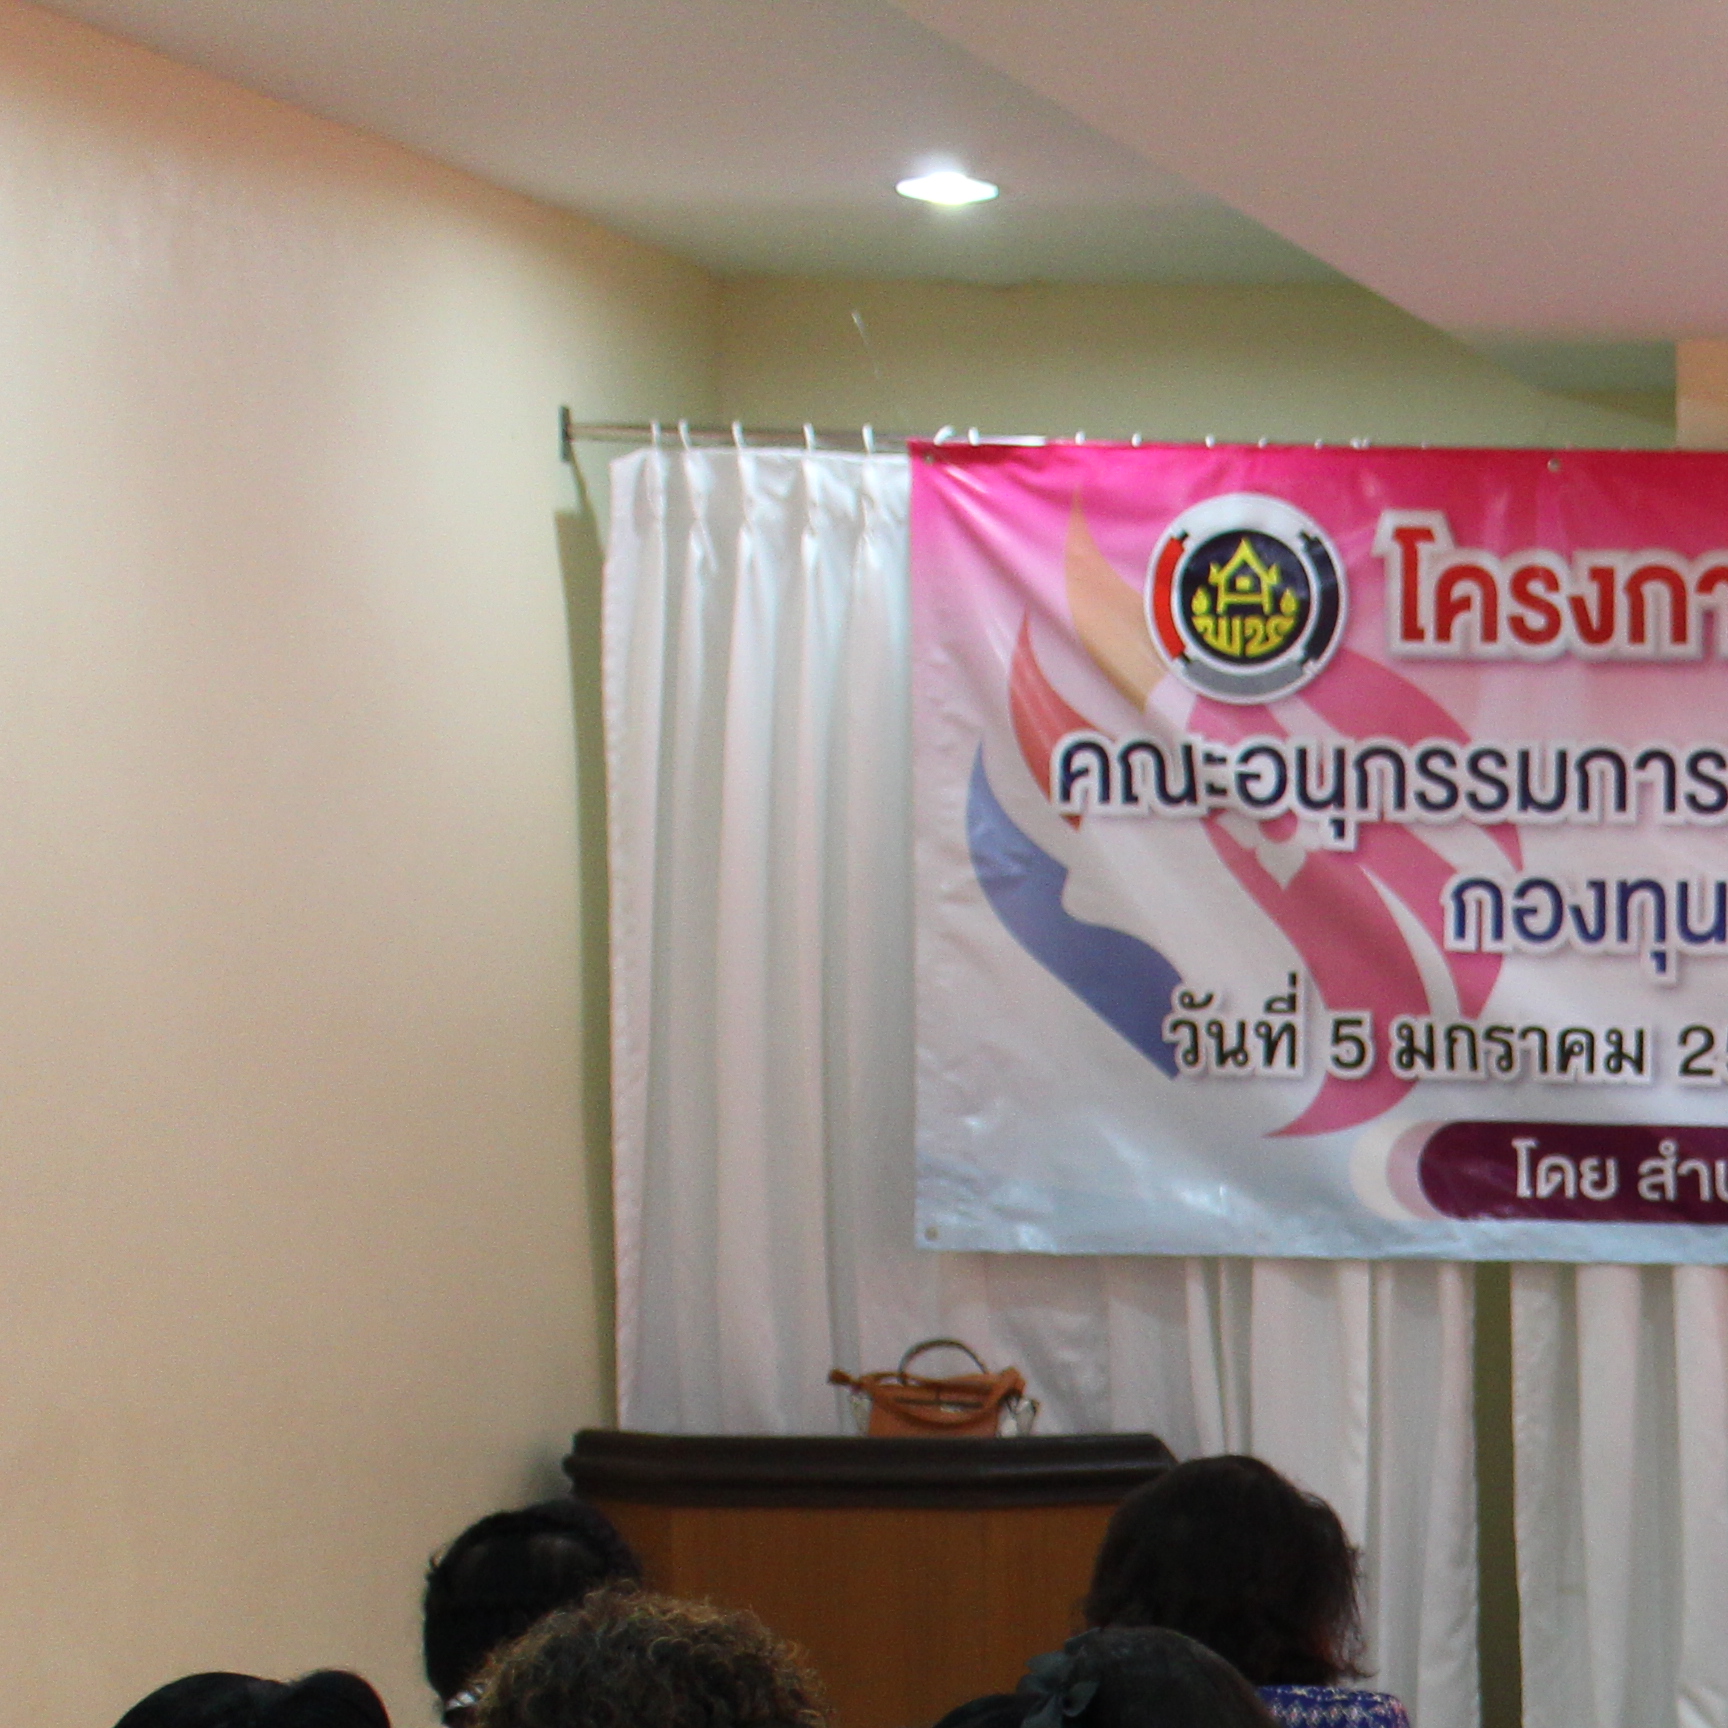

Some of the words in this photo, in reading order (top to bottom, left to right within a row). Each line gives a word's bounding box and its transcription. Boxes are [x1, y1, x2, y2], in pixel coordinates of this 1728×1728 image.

[1168, 971, 1298, 1068] วันที่
[1330, 1018, 1368, 1070] 5
[1397, 1021, 1645, 1075] มกราคม
[1511, 1136, 1618, 1199] โดย
